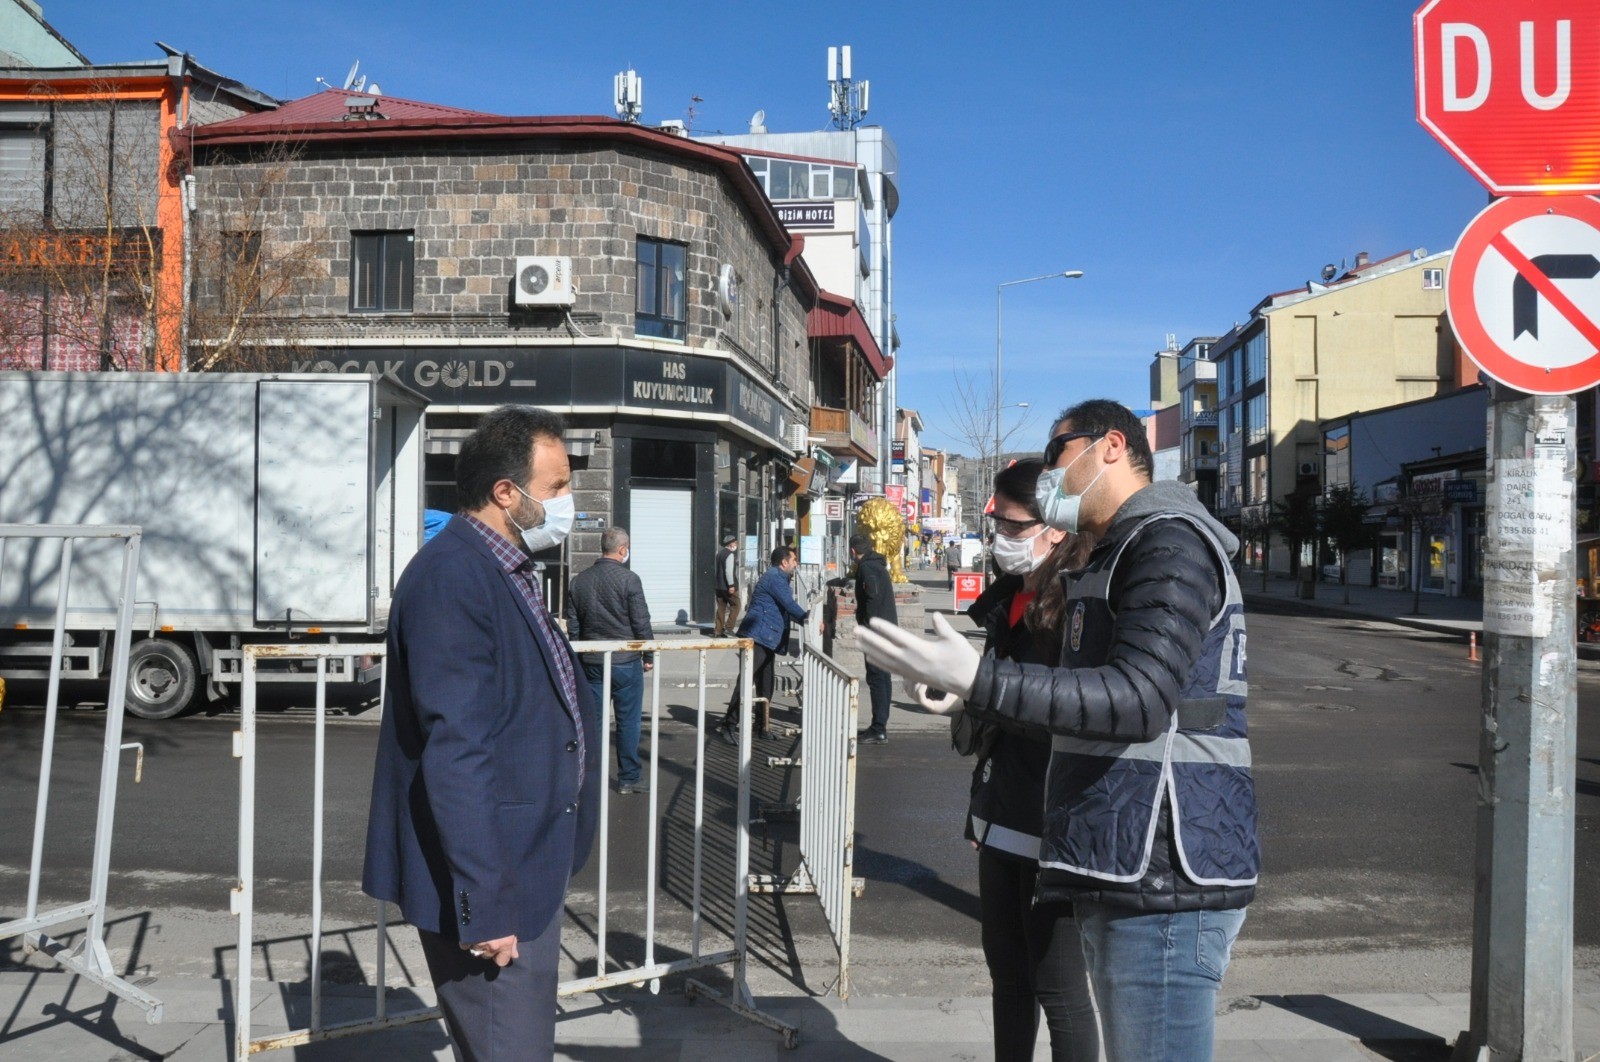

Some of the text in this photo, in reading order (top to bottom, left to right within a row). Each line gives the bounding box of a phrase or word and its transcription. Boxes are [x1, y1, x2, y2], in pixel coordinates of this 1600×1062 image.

[1441, 19, 1571, 112] DU
[805, 209, 833, 220] HOTEL
[662, 361, 686, 379] HAS
[633, 380, 714, 405] KUYUMCULUK
[1506, 497, 1521, 505] 2+1
[827, 504, 839, 516] E
